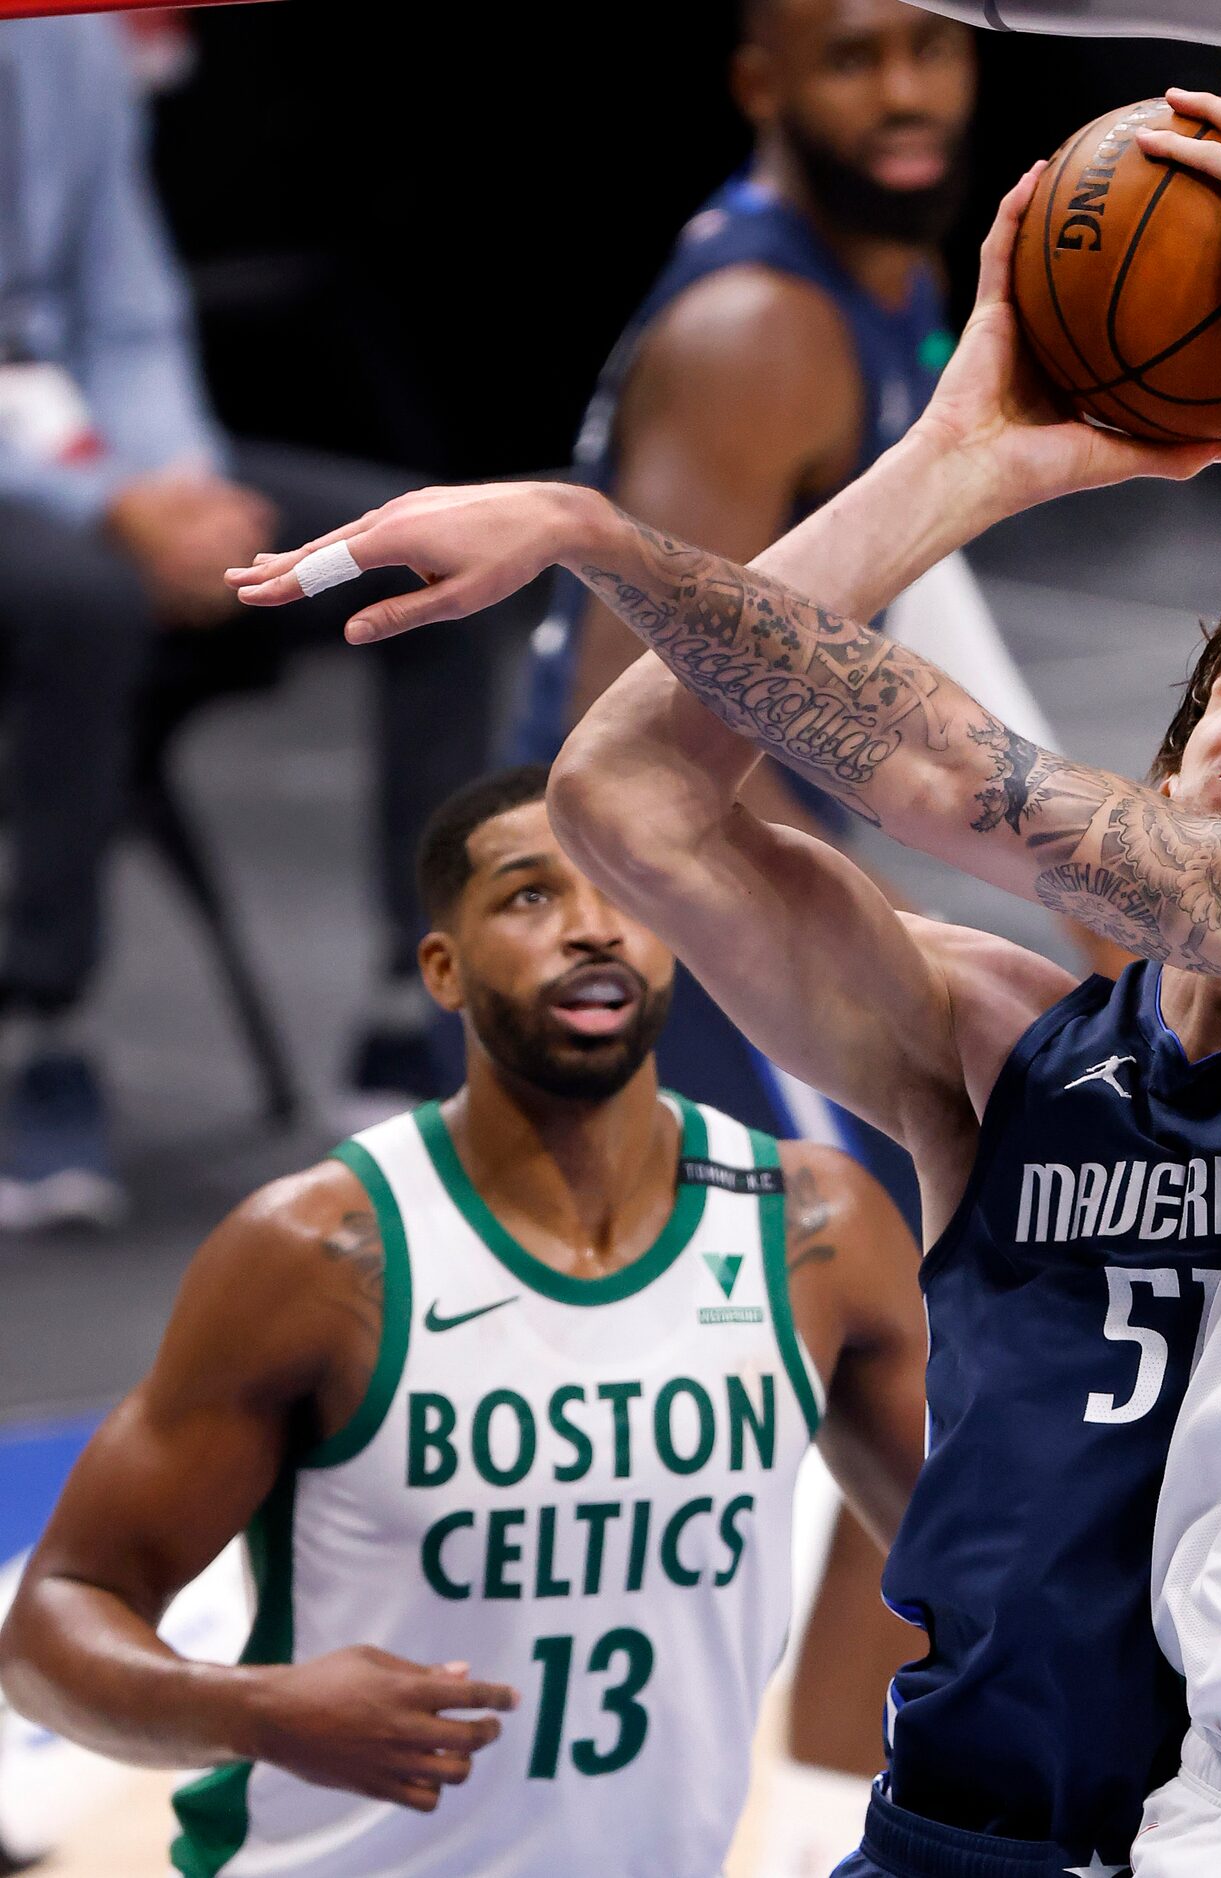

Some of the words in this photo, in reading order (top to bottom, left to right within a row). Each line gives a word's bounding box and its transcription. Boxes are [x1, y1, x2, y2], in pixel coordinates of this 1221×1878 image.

[407, 1372, 775, 1487] BOSTON
[421, 1495, 754, 1601] CELTICS
[527, 1626, 655, 1780] 13
